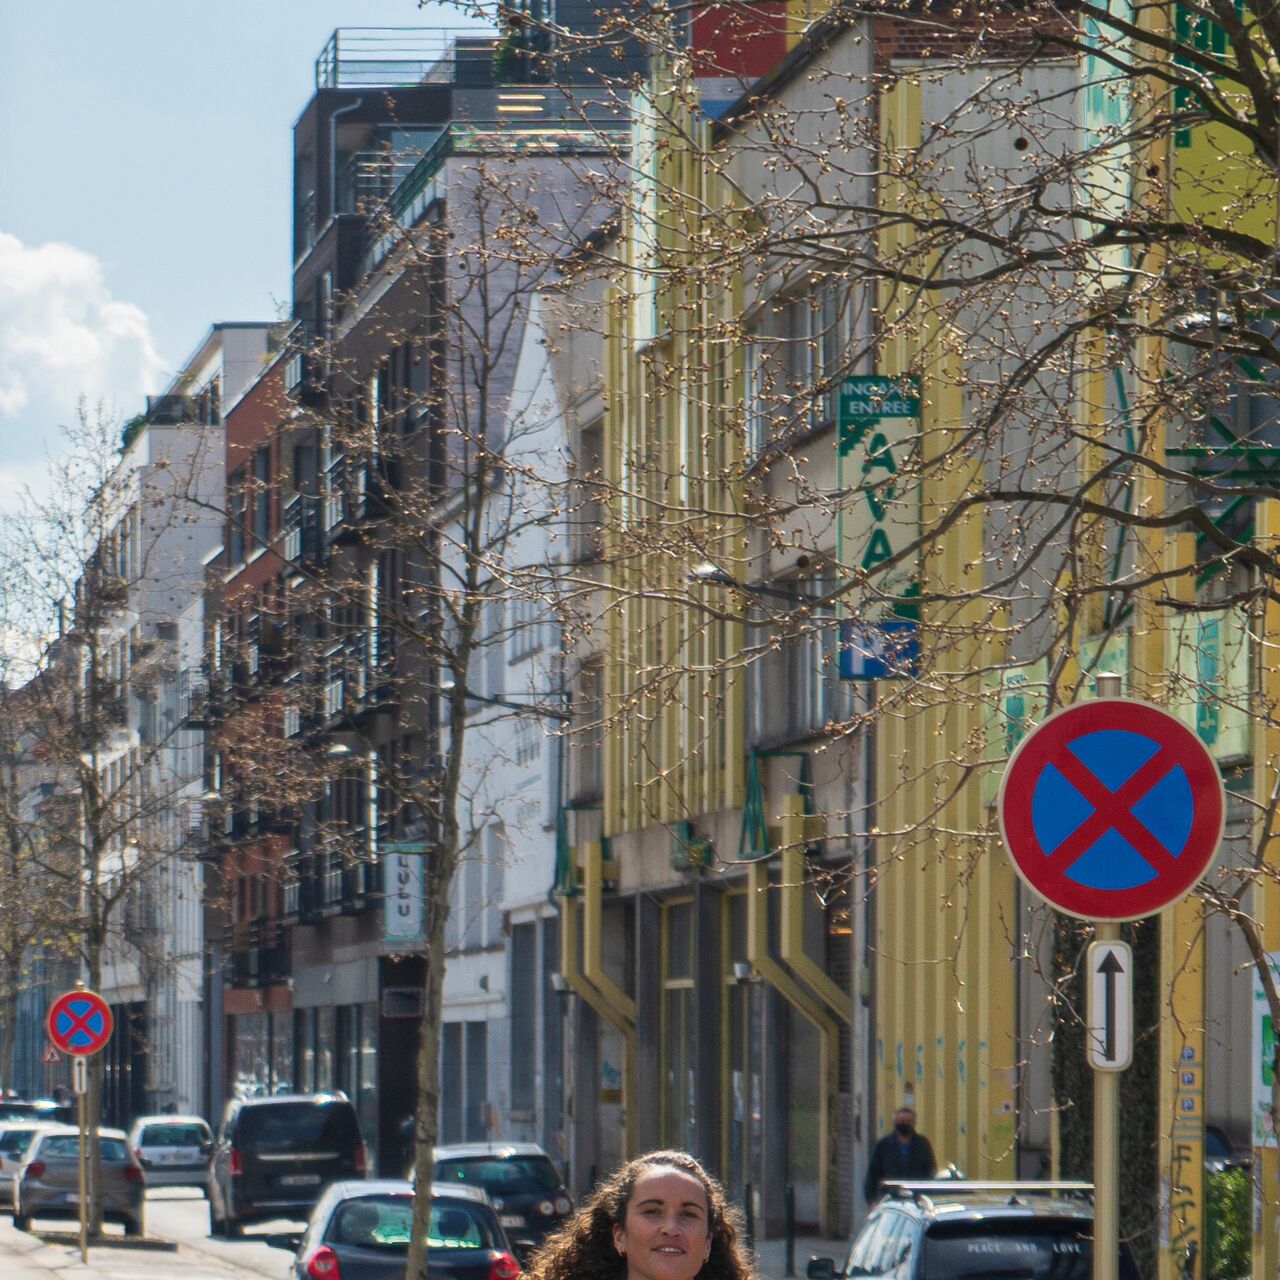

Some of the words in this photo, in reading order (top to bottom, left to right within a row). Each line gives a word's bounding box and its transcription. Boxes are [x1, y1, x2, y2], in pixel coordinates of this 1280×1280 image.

[842, 382, 918, 396] INGA
[967, 1243, 1000, 1253] PEACE
[1015, 1243, 1037, 1253] AND
[1053, 1243, 1081, 1253] LOVE
